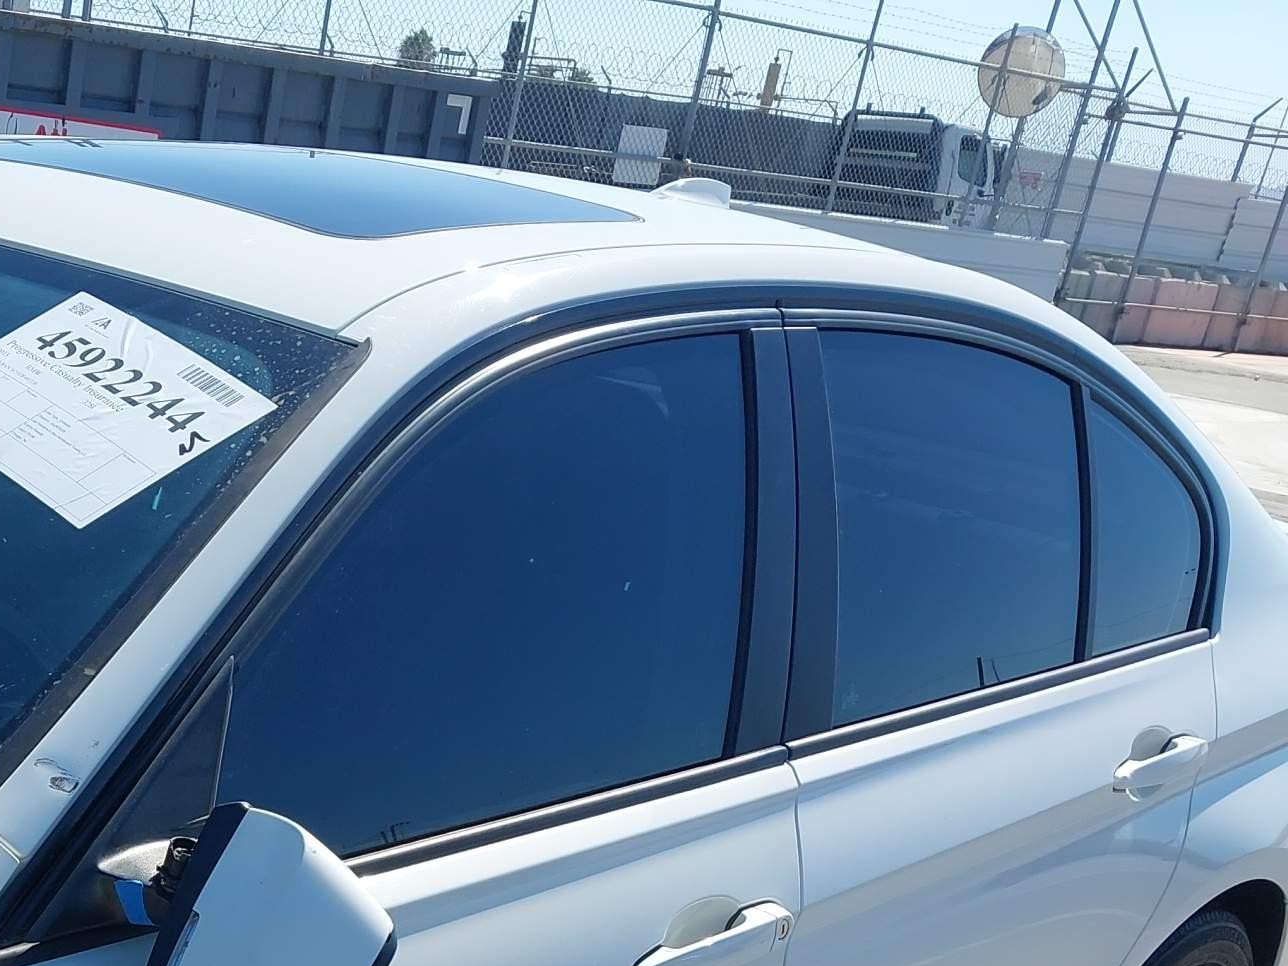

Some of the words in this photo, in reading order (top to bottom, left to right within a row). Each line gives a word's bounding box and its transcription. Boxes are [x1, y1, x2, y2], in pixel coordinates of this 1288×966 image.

[6, 340, 51, 368] Progressive
[50, 362, 83, 389] Casualty
[84, 384, 125, 412] Insurance
[36, 330, 206, 433] 45922244
